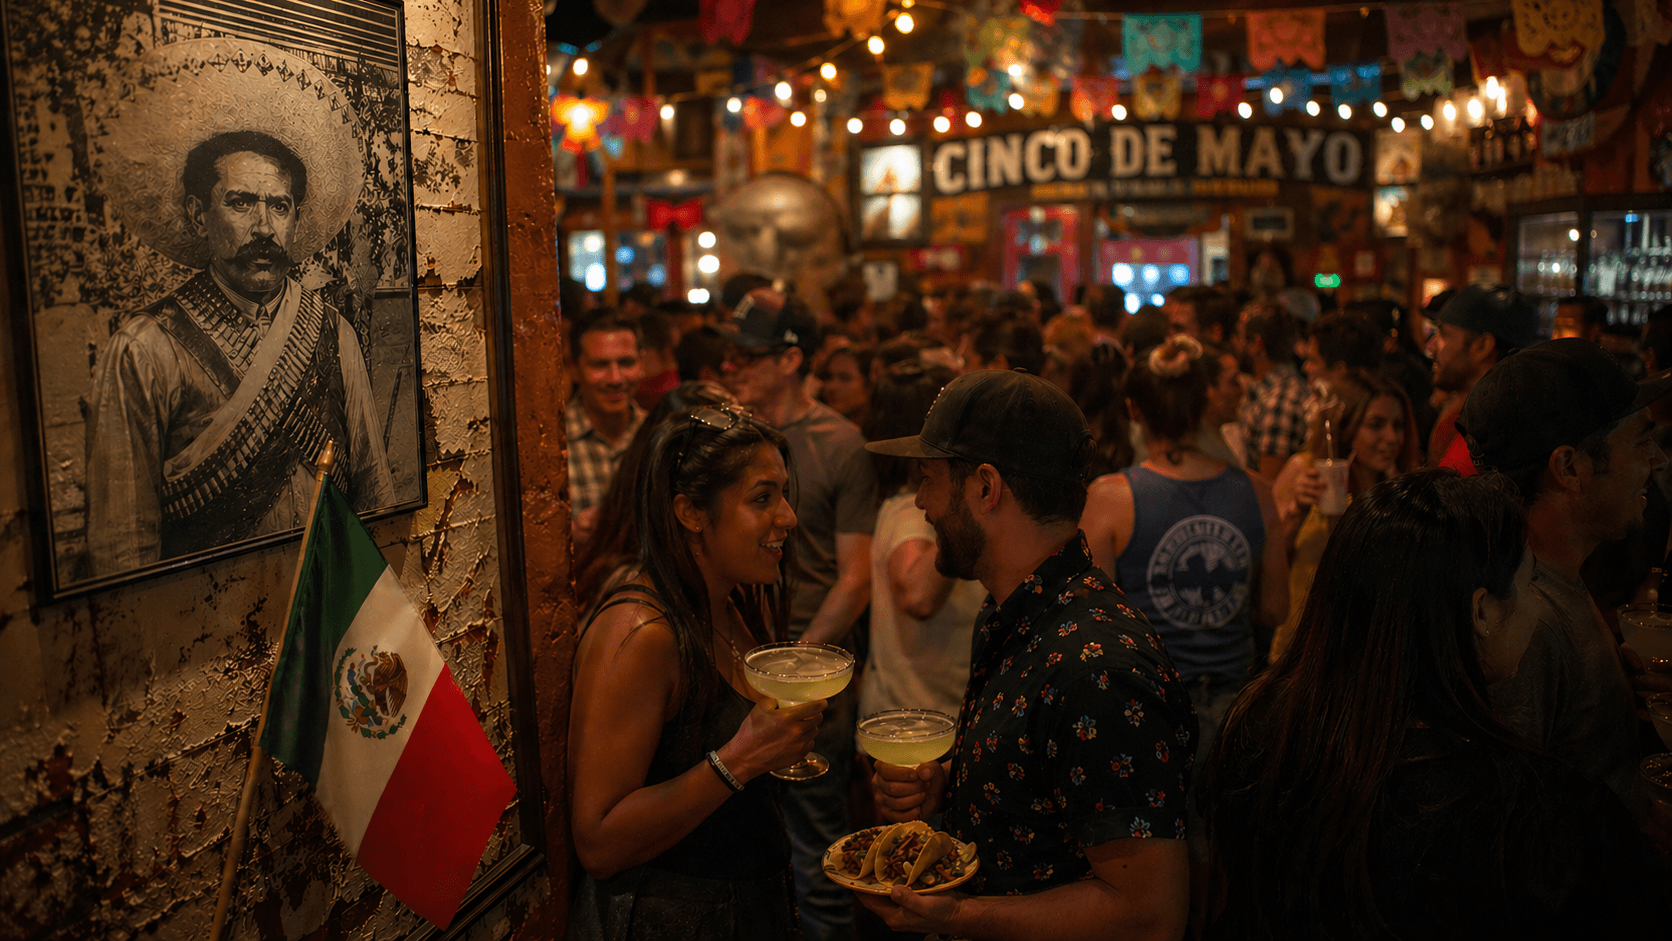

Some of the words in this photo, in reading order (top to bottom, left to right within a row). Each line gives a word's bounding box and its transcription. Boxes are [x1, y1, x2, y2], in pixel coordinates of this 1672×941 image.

[933, 128, 1092, 195] CINCO
[1110, 124, 1178, 177] DE
[1196, 125, 1362, 184] MAYO
